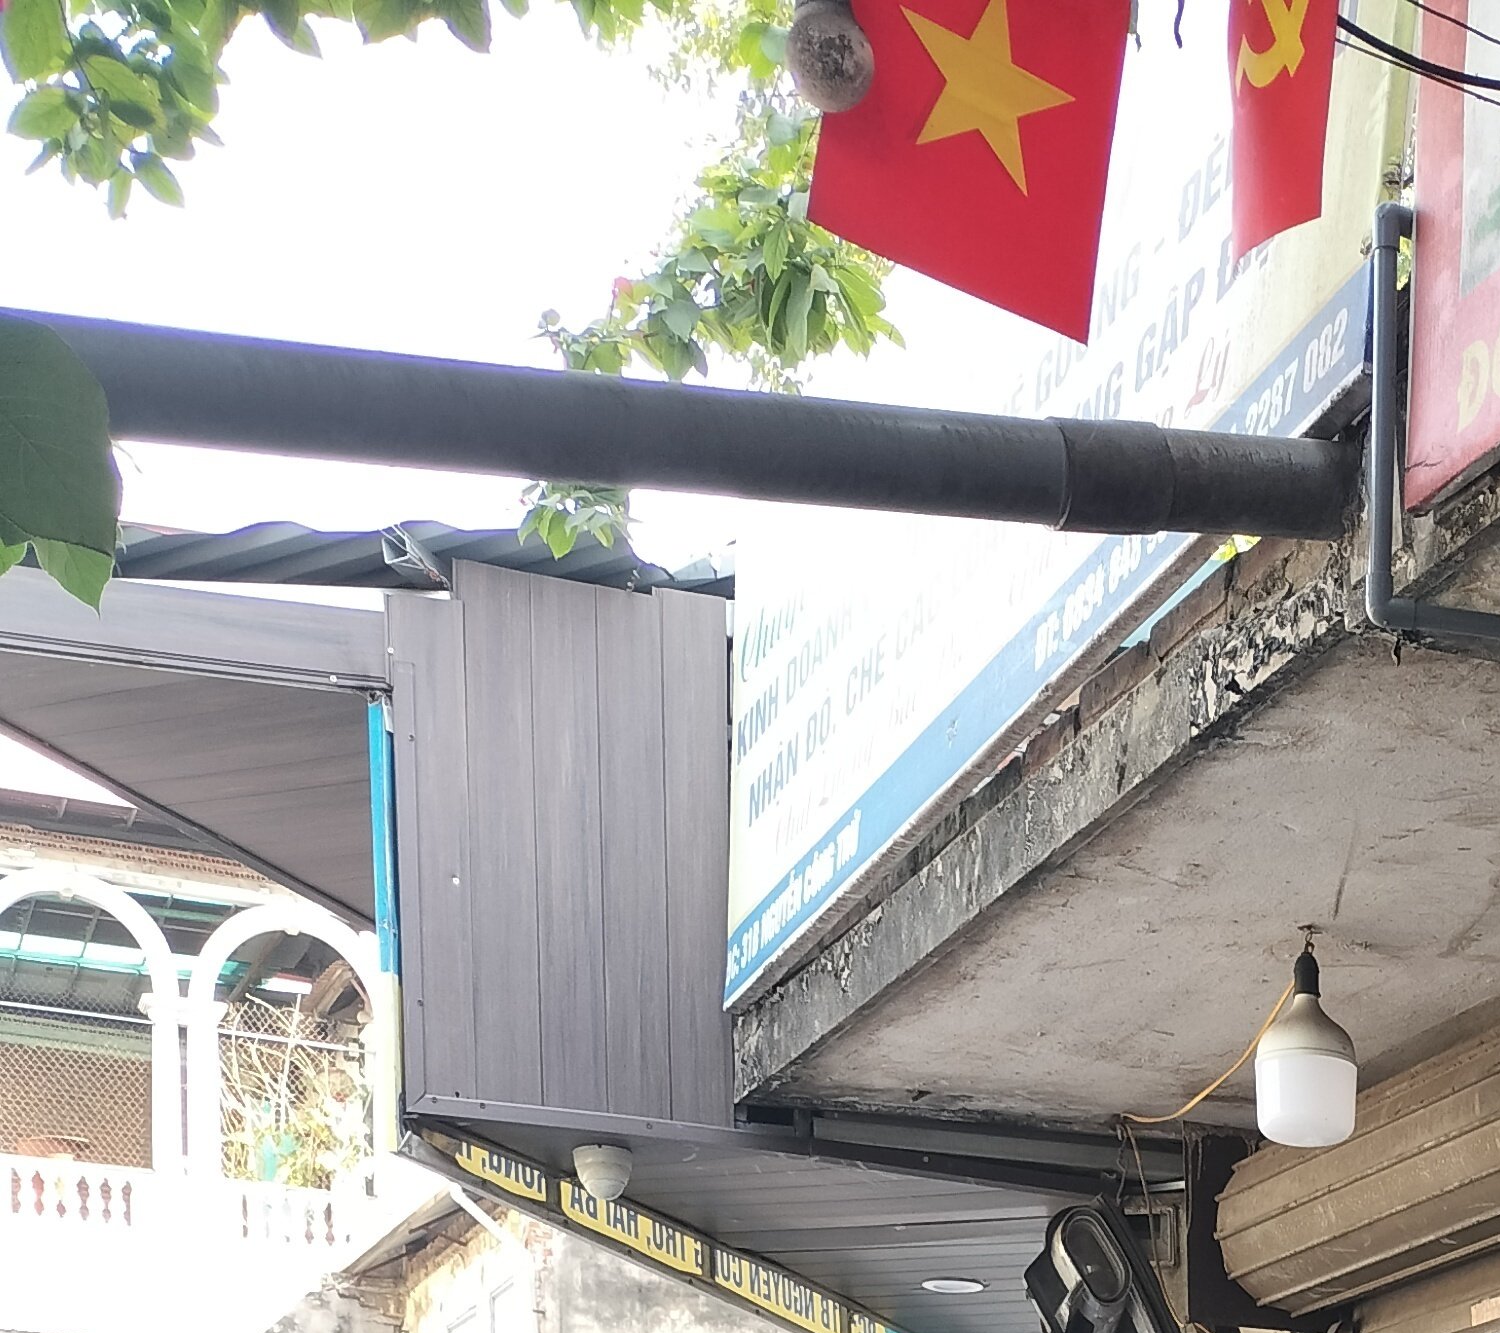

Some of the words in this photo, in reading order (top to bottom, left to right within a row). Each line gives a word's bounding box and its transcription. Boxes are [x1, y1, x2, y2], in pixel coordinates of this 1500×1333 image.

[737, 675, 778, 766] KINH
[1178, 132, 1232, 244] ĐÈ
[1302, 307, 1349, 394] 082
